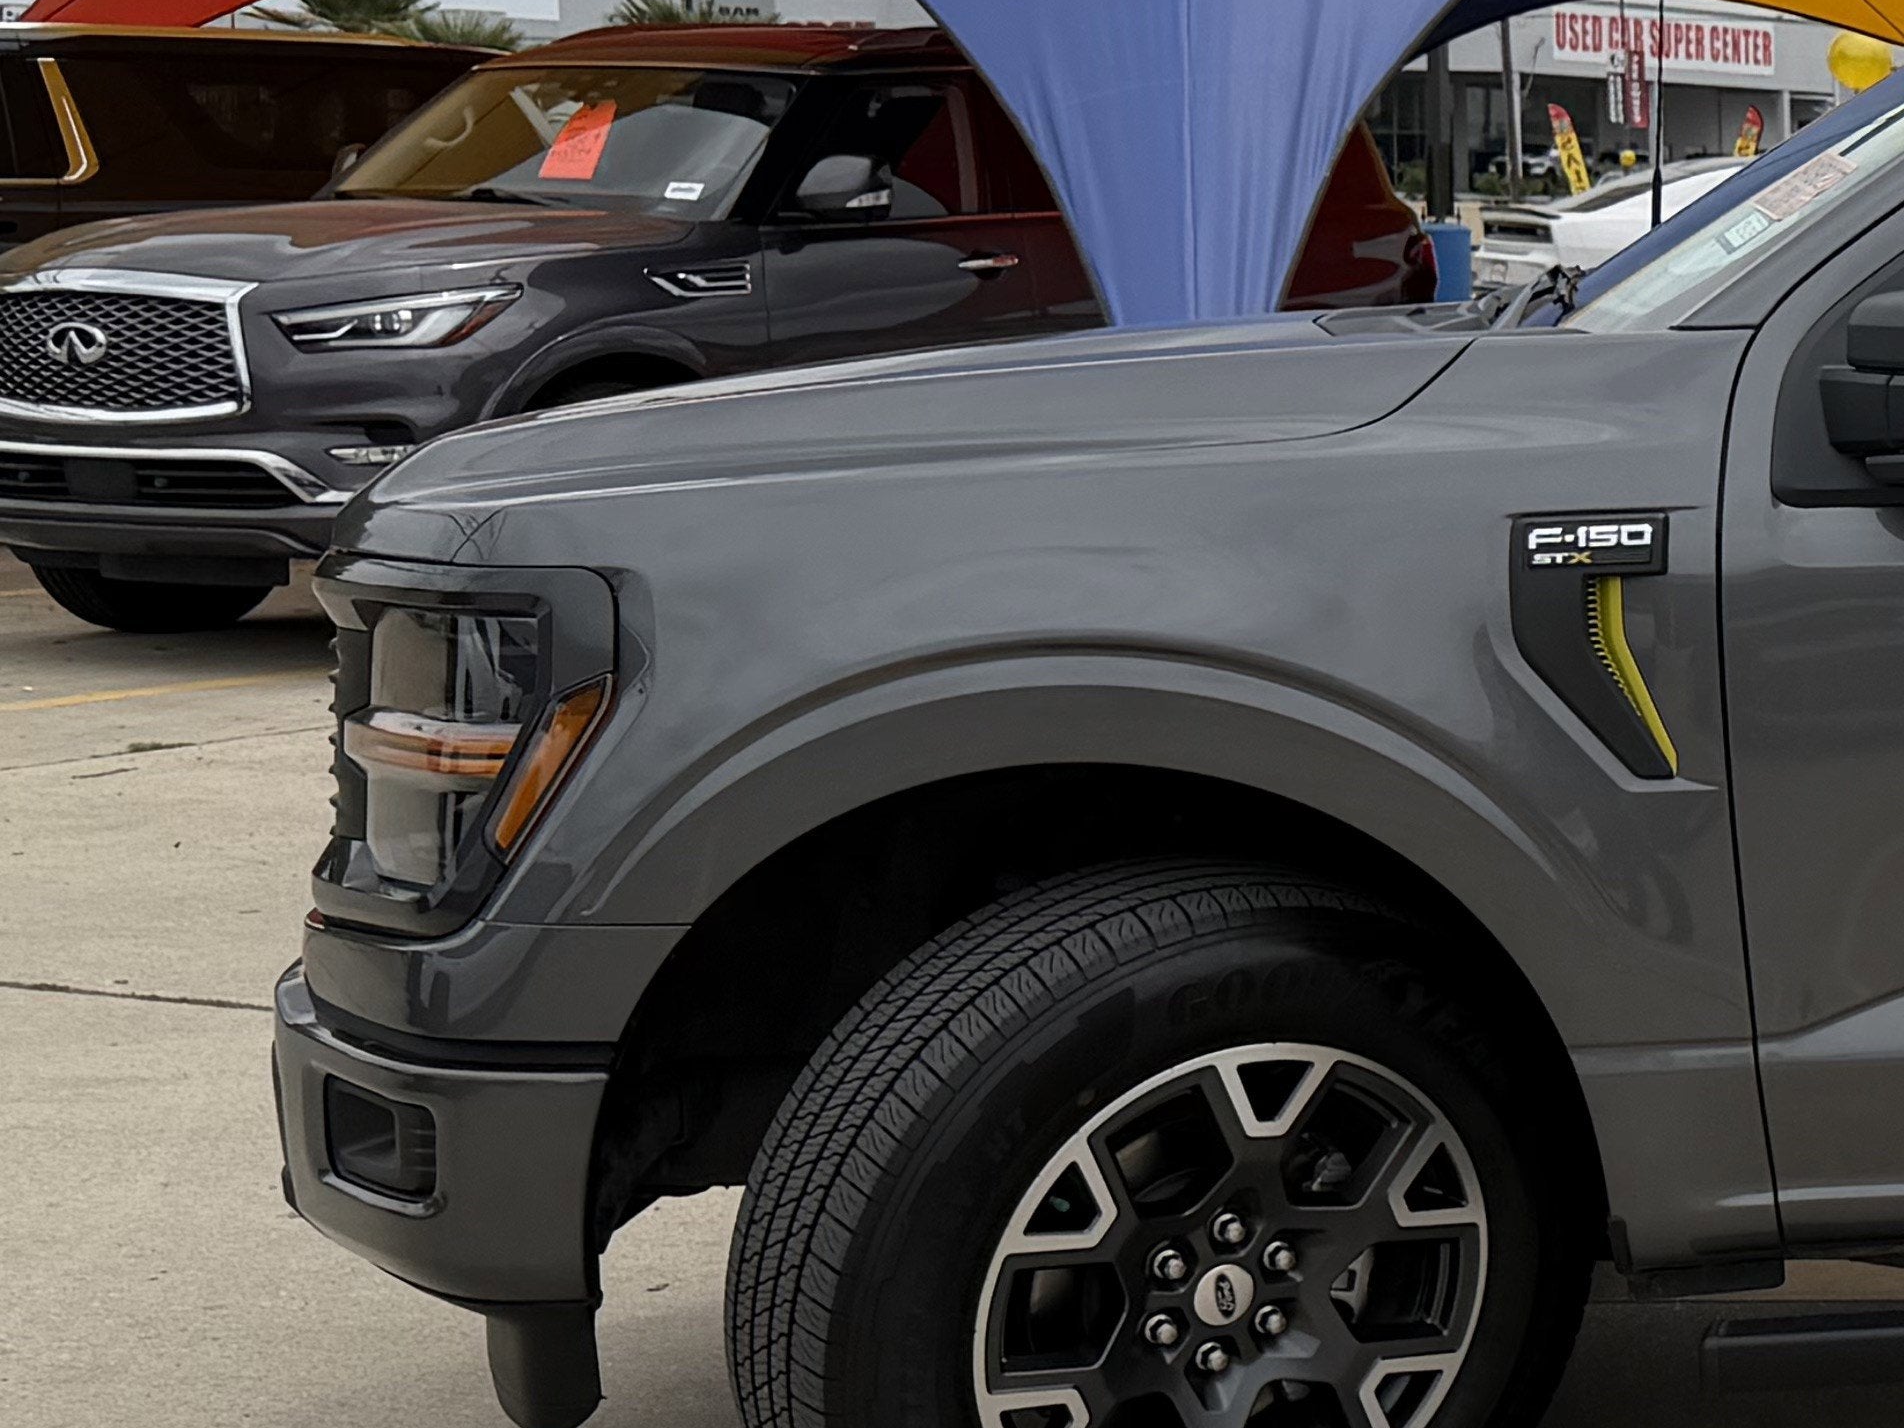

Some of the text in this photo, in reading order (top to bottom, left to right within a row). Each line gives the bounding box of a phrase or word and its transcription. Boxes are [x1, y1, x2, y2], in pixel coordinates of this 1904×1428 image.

[1554, 11, 1773, 67] USED CAR SUPER CENTER
[1528, 523, 1653, 550] F-150
[1531, 551, 1593, 565] STX
